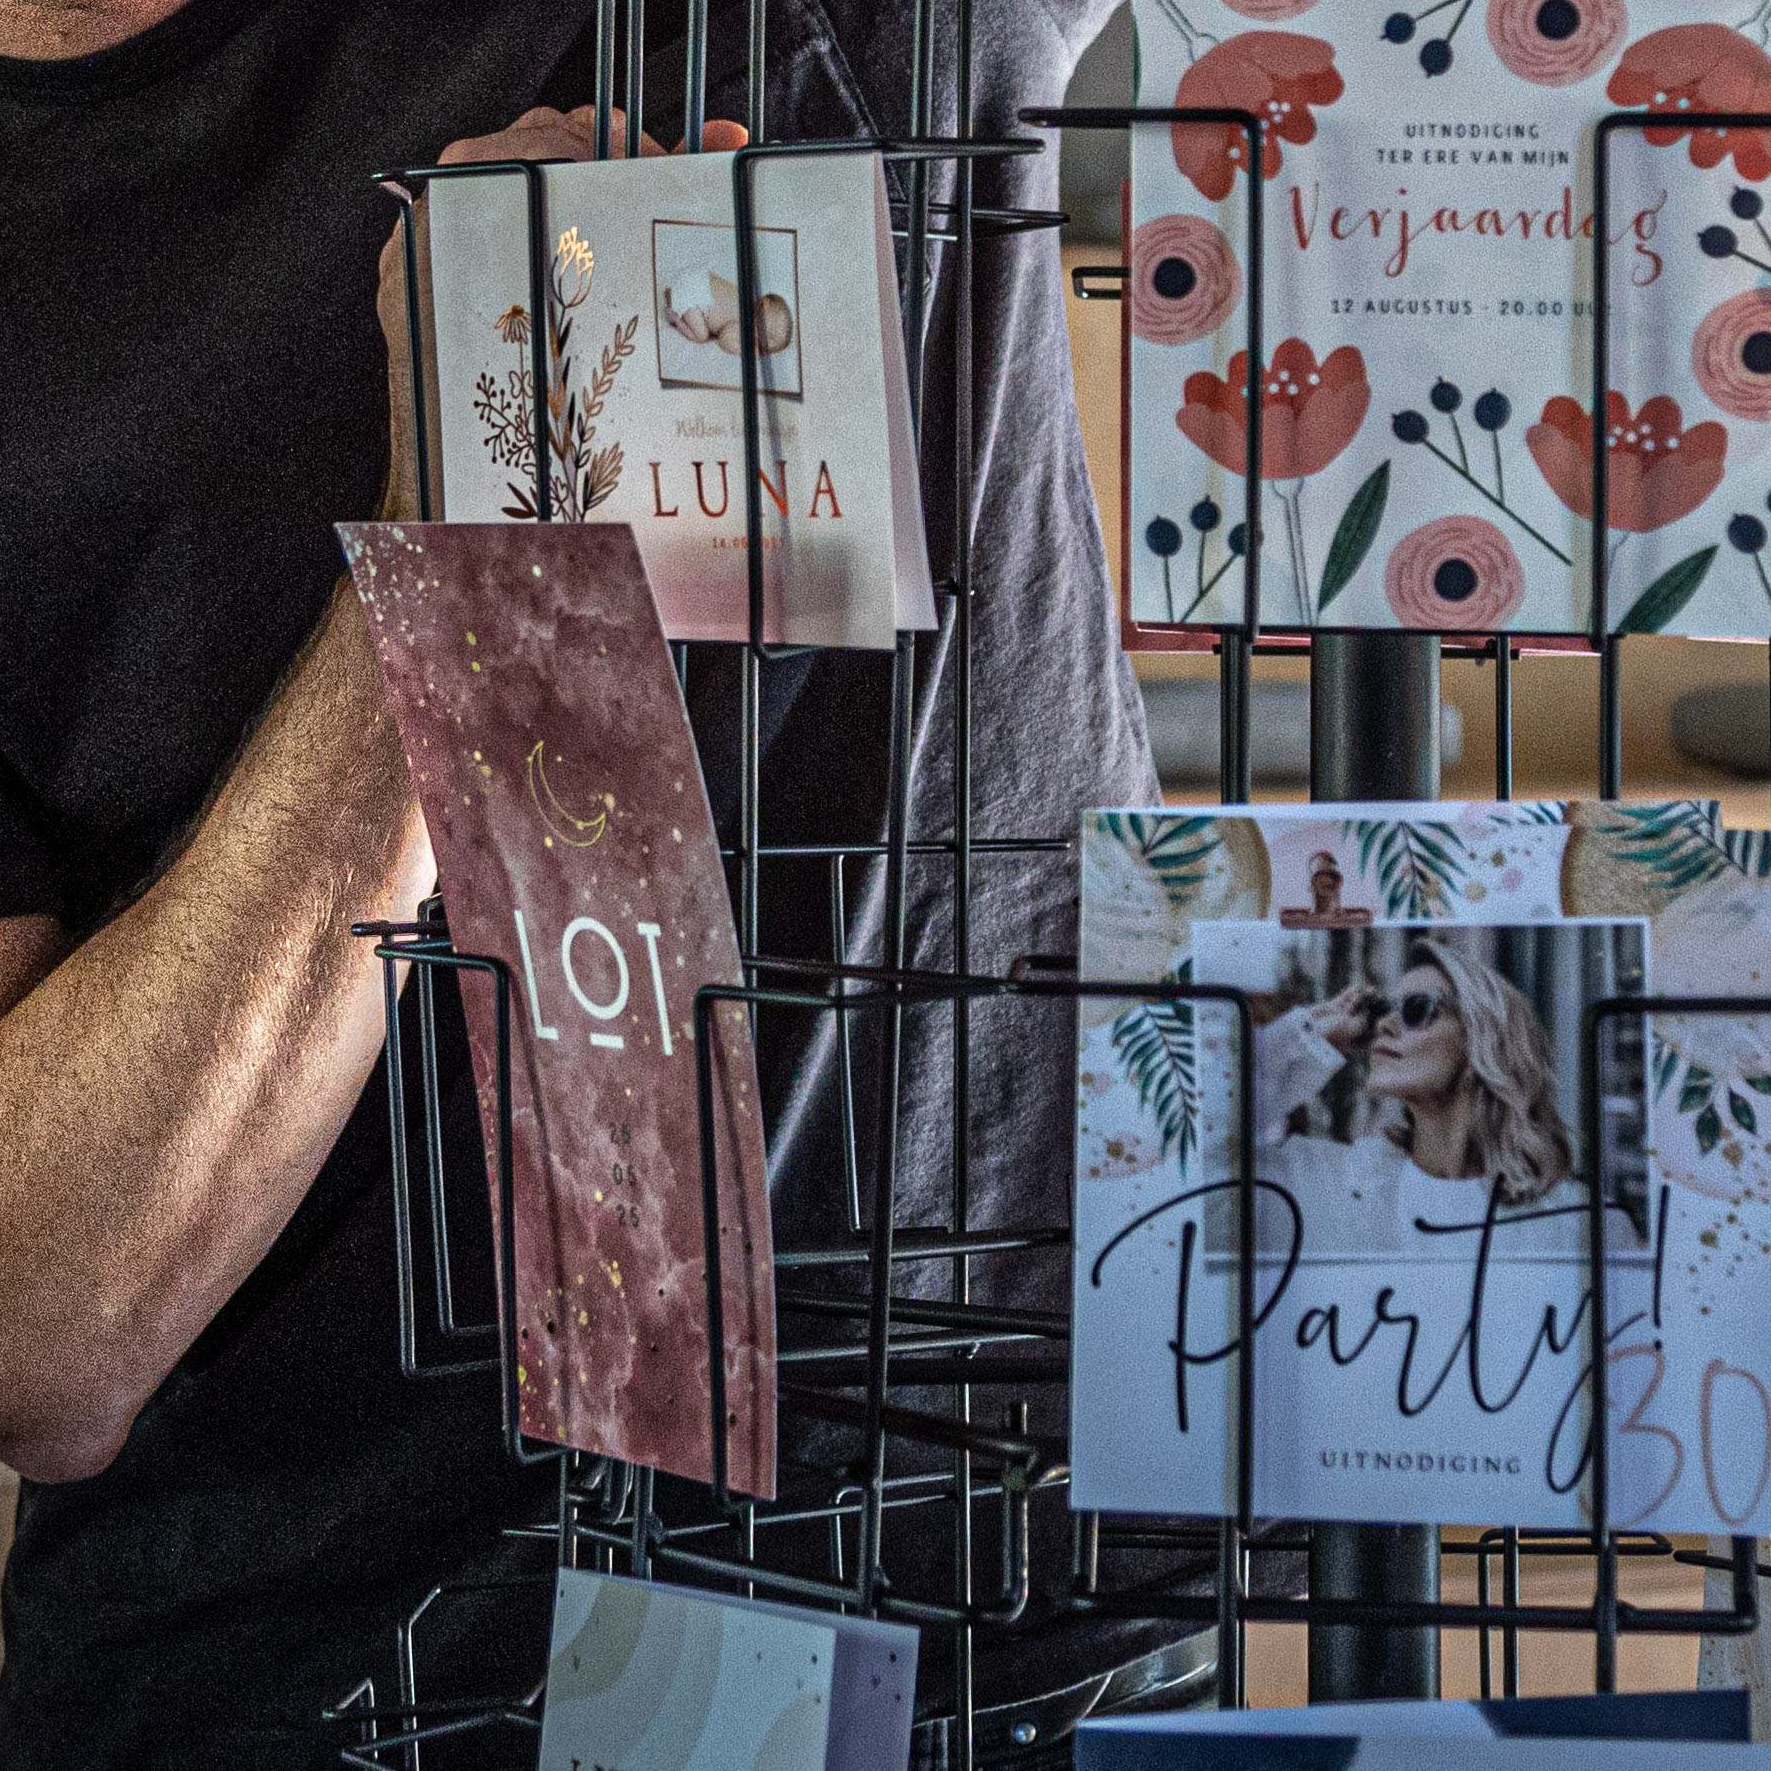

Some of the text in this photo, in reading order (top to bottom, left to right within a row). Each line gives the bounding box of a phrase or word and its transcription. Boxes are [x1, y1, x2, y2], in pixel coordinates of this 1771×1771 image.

[1405, 122, 1541, 140] UITNODIGING
[1377, 148, 1570, 167] TER ERE VAN MIJN
[1329, 298, 1353, 315] 12
[1364, 298, 1473, 315] AUGUSTUS
[647, 459, 844, 519] LUNA
[513, 909, 674, 1056] LOT
[1090, 1173, 1671, 1495] Party!
[1321, 1449, 1523, 1477] UITNODIGING
